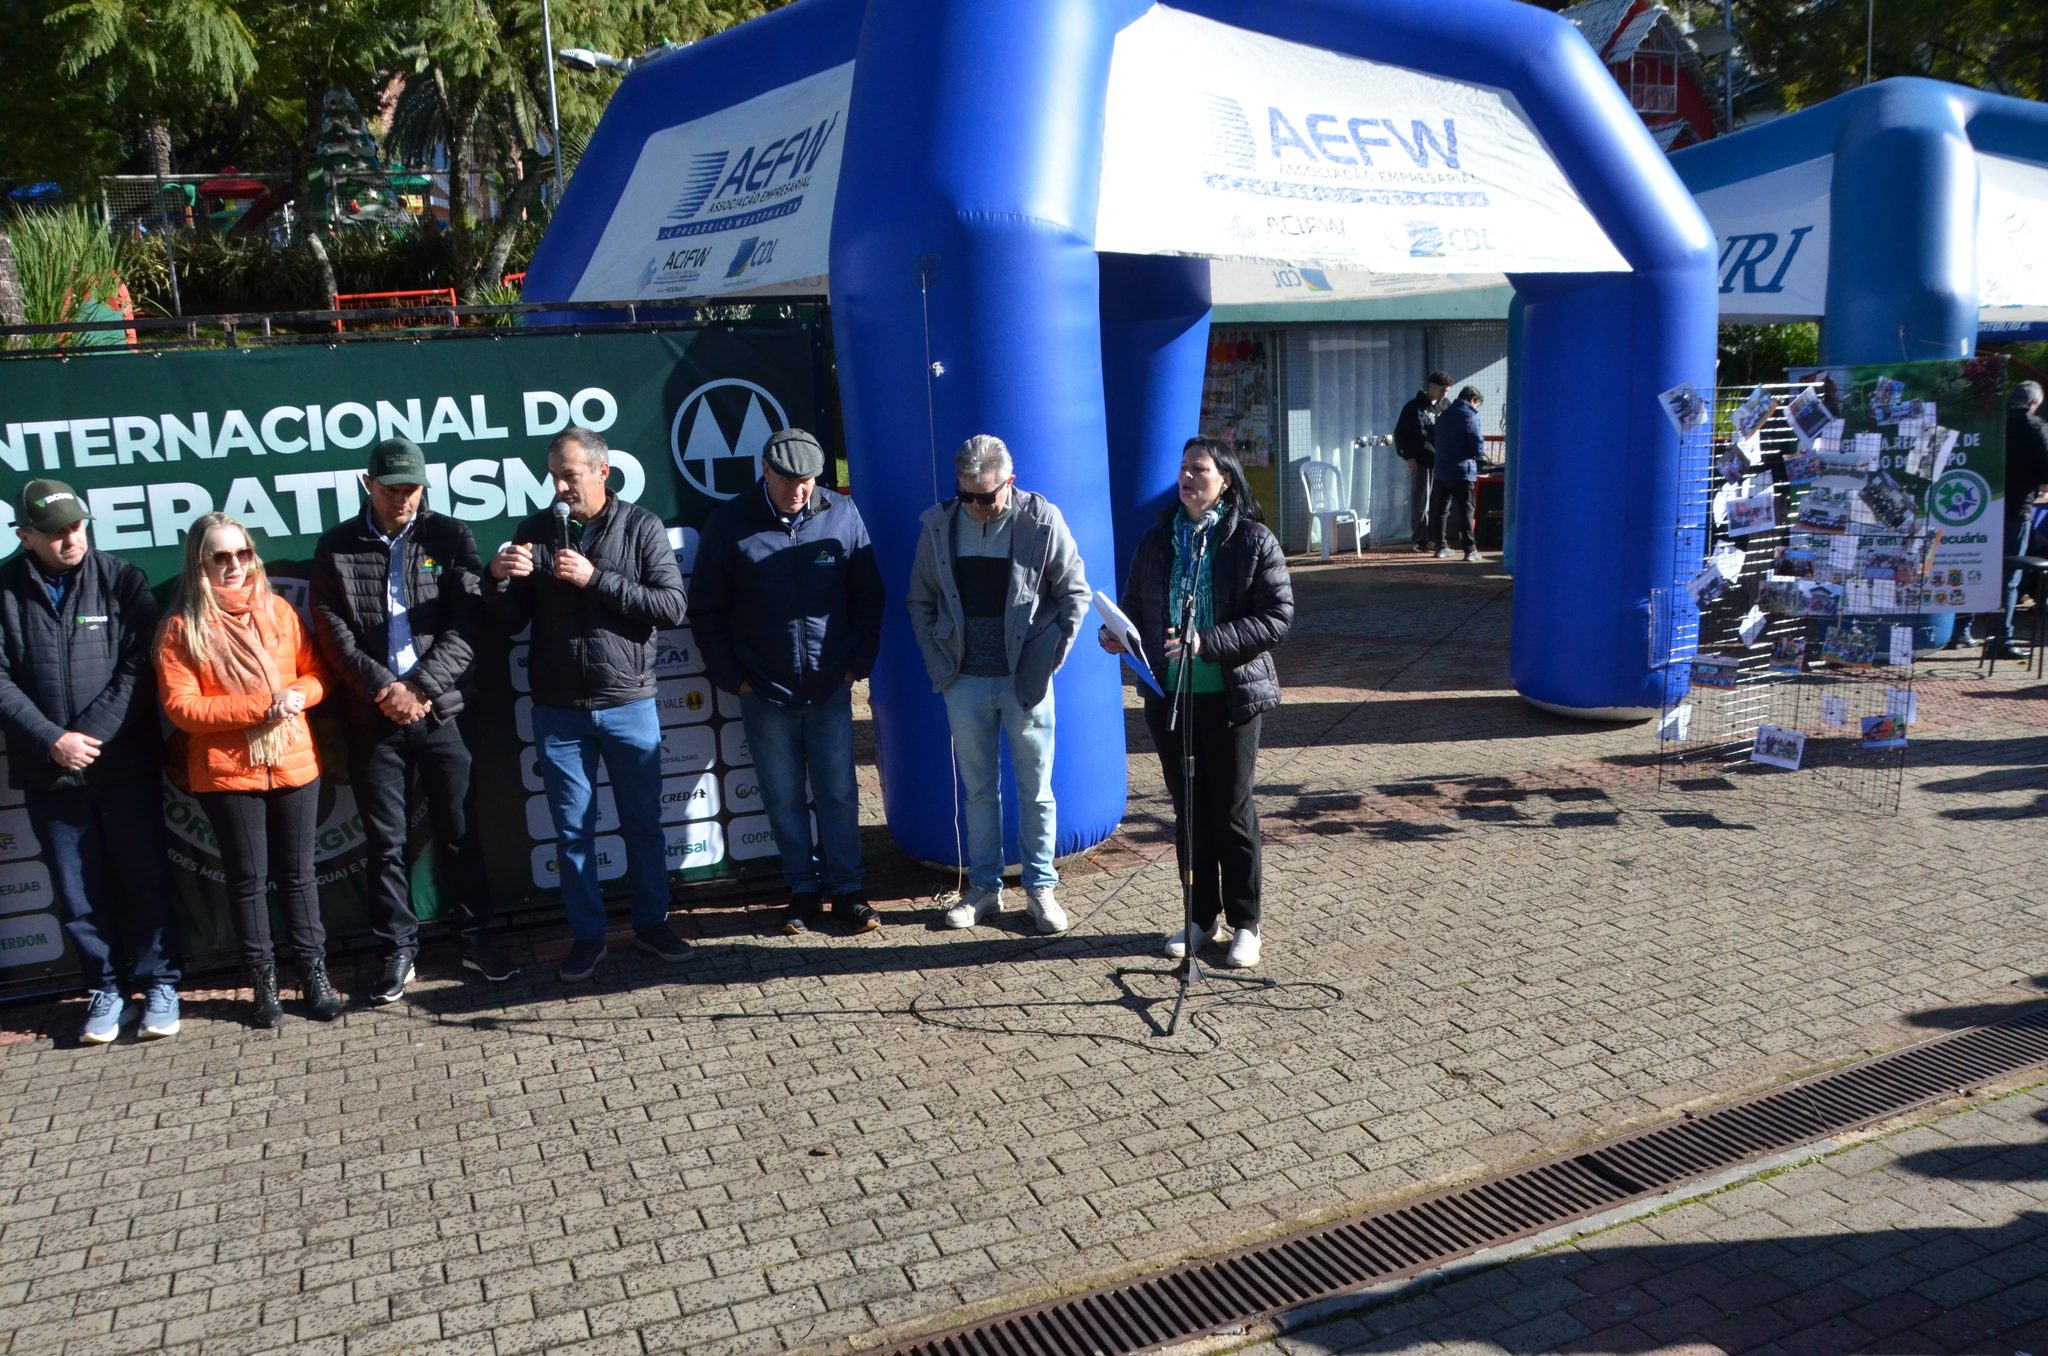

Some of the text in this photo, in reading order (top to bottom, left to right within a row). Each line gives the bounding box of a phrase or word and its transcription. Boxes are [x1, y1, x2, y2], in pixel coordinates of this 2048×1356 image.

[1268, 106, 1460, 169] AEFW
[714, 110, 840, 199] AEFW
[707, 191, 760, 214] ASSOCIAÇÃO
[676, 220, 733, 237] FREDERICO
[735, 201, 802, 229] WESTPHALEN
[663, 247, 712, 271] ACIFW
[750, 237, 779, 267] CDL
[523, 387, 617, 437] DO
[1963, 433, 1980, 447] DE
[1941, 532, 1987, 544] ecuária
[663, 698, 684, 710] VALE
[662, 791, 691, 803] CRED
[664, 839, 707, 857] trisal
